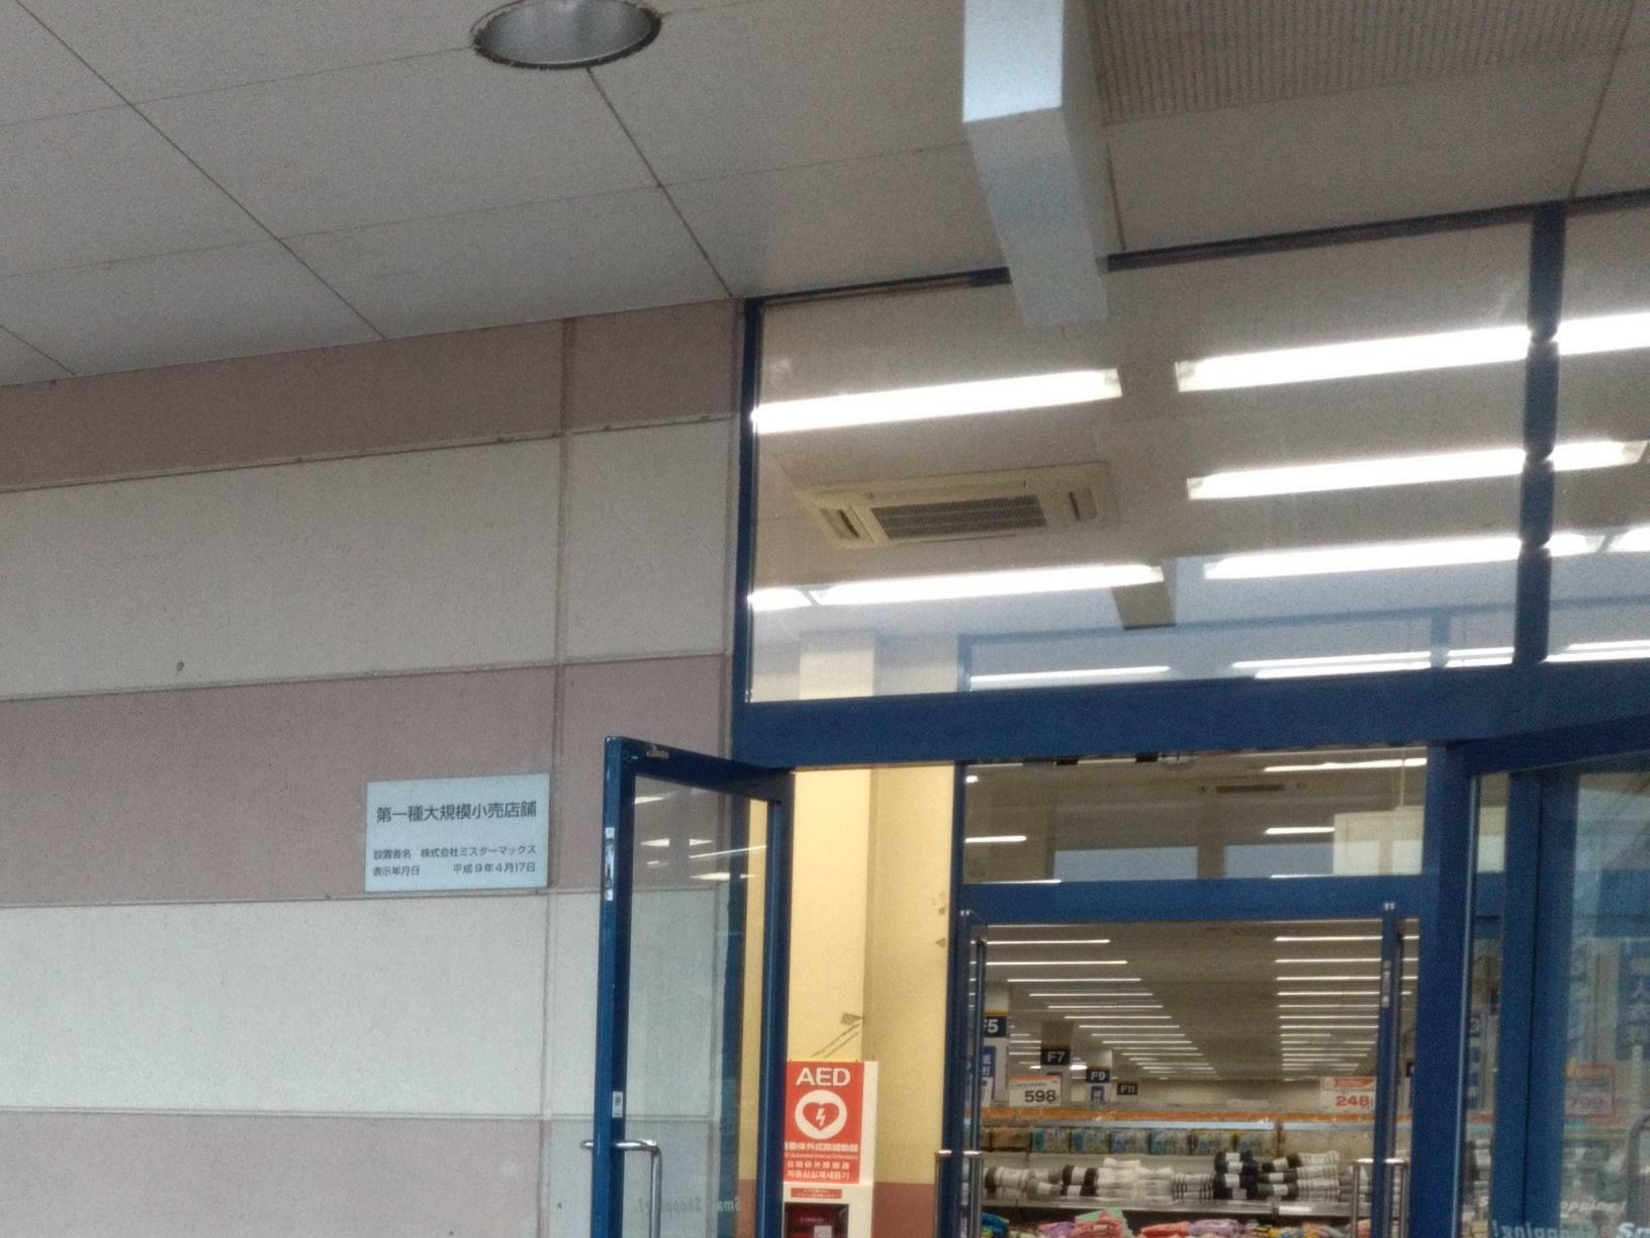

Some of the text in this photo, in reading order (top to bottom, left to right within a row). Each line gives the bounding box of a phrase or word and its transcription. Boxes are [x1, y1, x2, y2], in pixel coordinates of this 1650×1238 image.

[376, 800, 537, 823] 第一種大規模小売店舗
[373, 844, 537, 861] 設置者名 株式会社ミスターマックス
[372, 861, 537, 877] 表示年月日 平成9年4月17日
[985, 1018, 999, 1034] 5
[1046, 1050, 1066, 1063] F7
[795, 1066, 852, 1087] AED
[1090, 1070, 1107, 1082] F9
[1024, 1089, 1057, 1103] 598
[1335, 1095, 1370, 1107] 248
